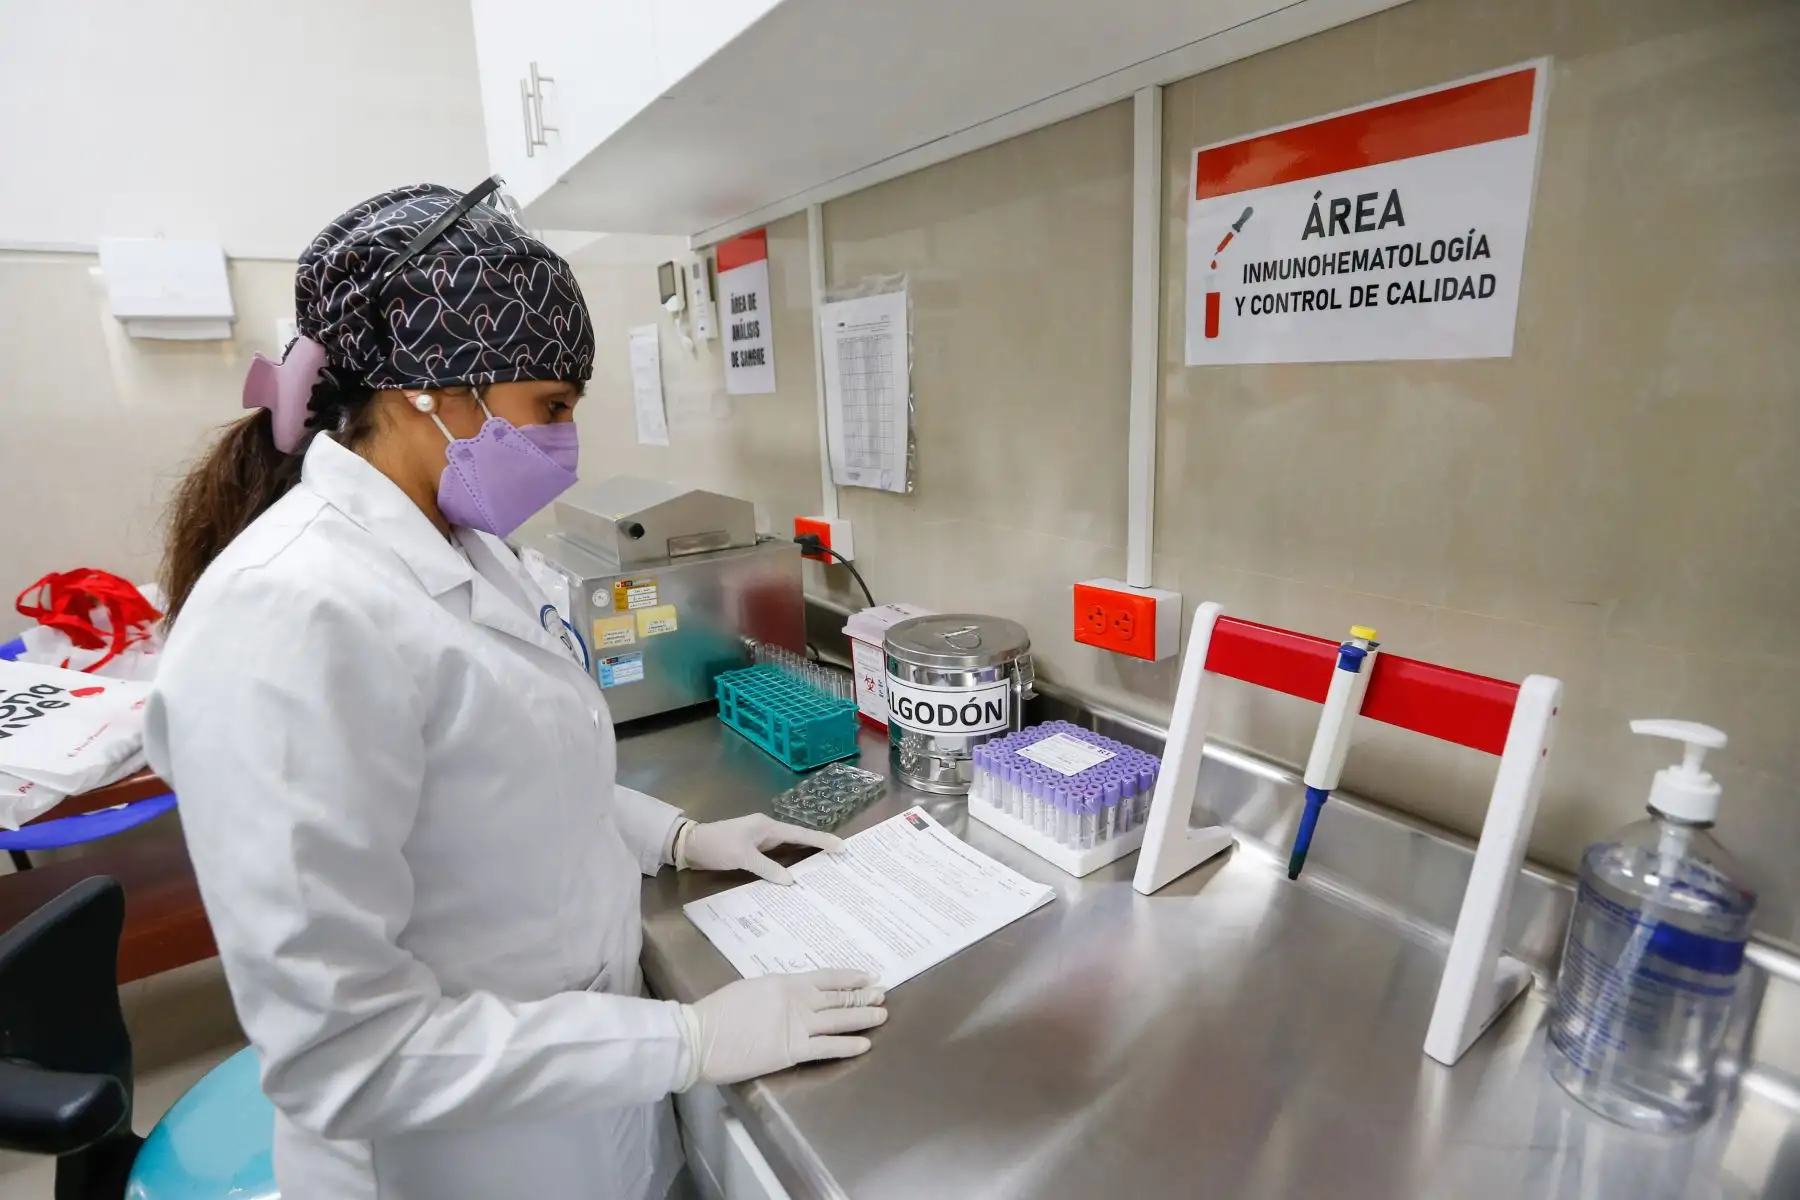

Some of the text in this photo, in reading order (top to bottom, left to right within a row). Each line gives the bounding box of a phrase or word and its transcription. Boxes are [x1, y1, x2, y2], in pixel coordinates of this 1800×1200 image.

[1301, 189, 1405, 240] ÁREA
[1243, 228, 1491, 284] INMUNOHEMATOLOGÍA
[731, 292, 757, 314] ÁREA DE
[1235, 273, 1496, 316] Y CONTROL DE CALIDAD
[731, 347, 765, 367] DE SANGRE
